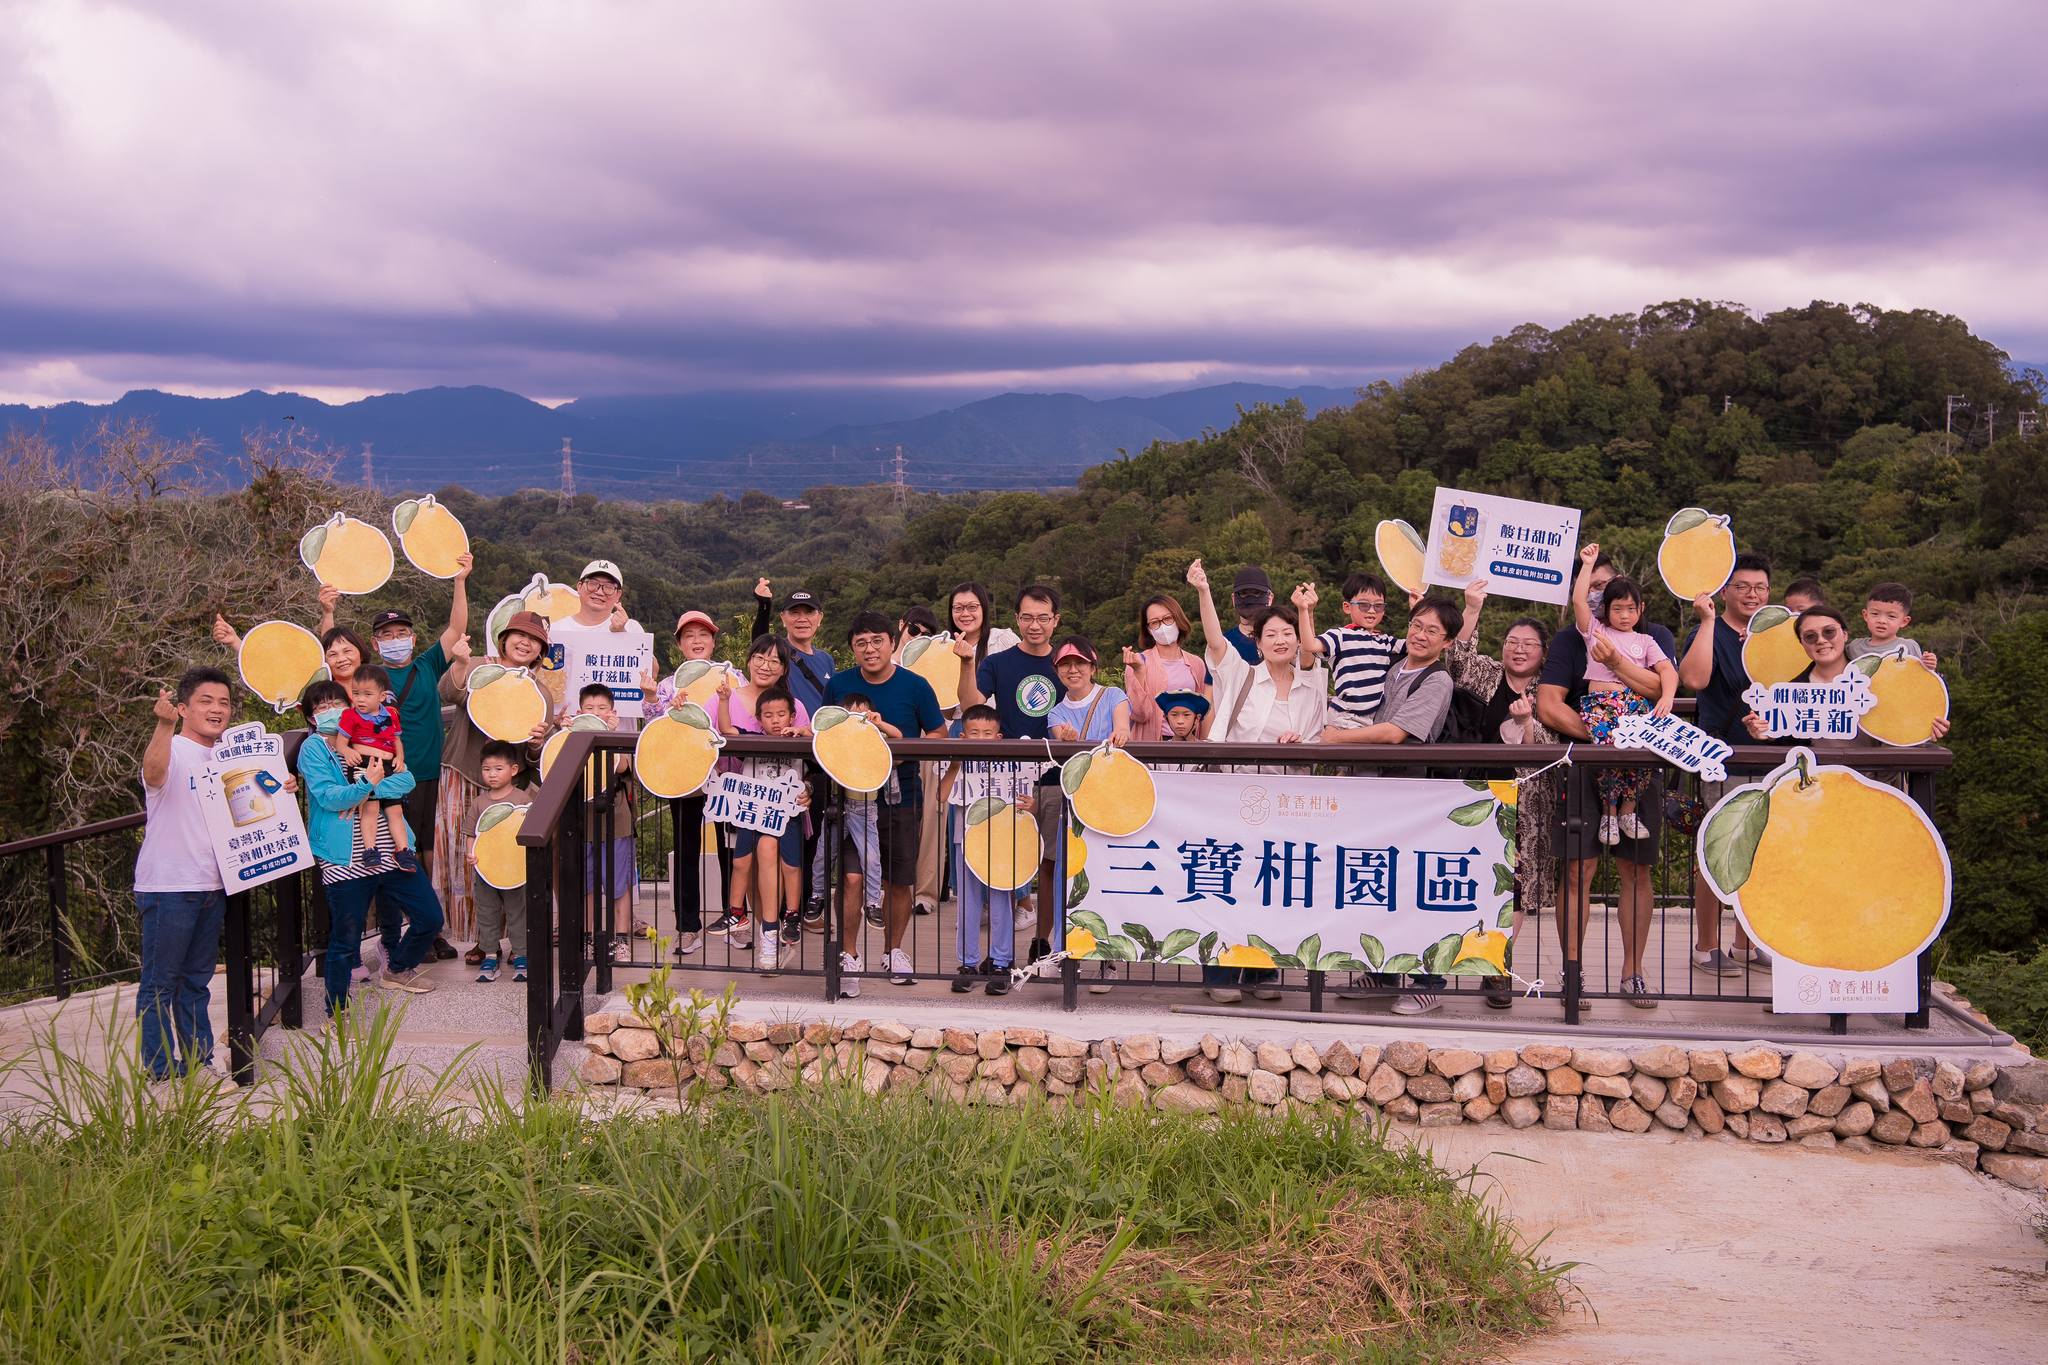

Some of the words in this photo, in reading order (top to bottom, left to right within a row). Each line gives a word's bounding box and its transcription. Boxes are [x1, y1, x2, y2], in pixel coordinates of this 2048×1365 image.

[1500, 524, 1561, 547] 酸甘甜的
[1506, 543, 1551, 563] 好滋味
[585, 654, 639, 668] 酸甘甜的
[592, 670, 631, 683] 好滋味
[1773, 688, 1846, 705] 柑橘界的
[1765, 708, 1854, 734] 小清新
[234, 730, 257, 743] 媲美
[220, 741, 275, 760] 韓國柚子茶
[1639, 730, 1701, 768] 柑橘界的
[723, 778, 783, 804] 柑橘界的
[952, 776, 1029, 800] 小清新
[708, 795, 785, 831] 小清新
[229, 822, 289, 850] 臺灣第一支
[226, 835, 300, 869] 三寶柑果茶醬
[1101, 838, 1482, 912] 三寶柑園區
